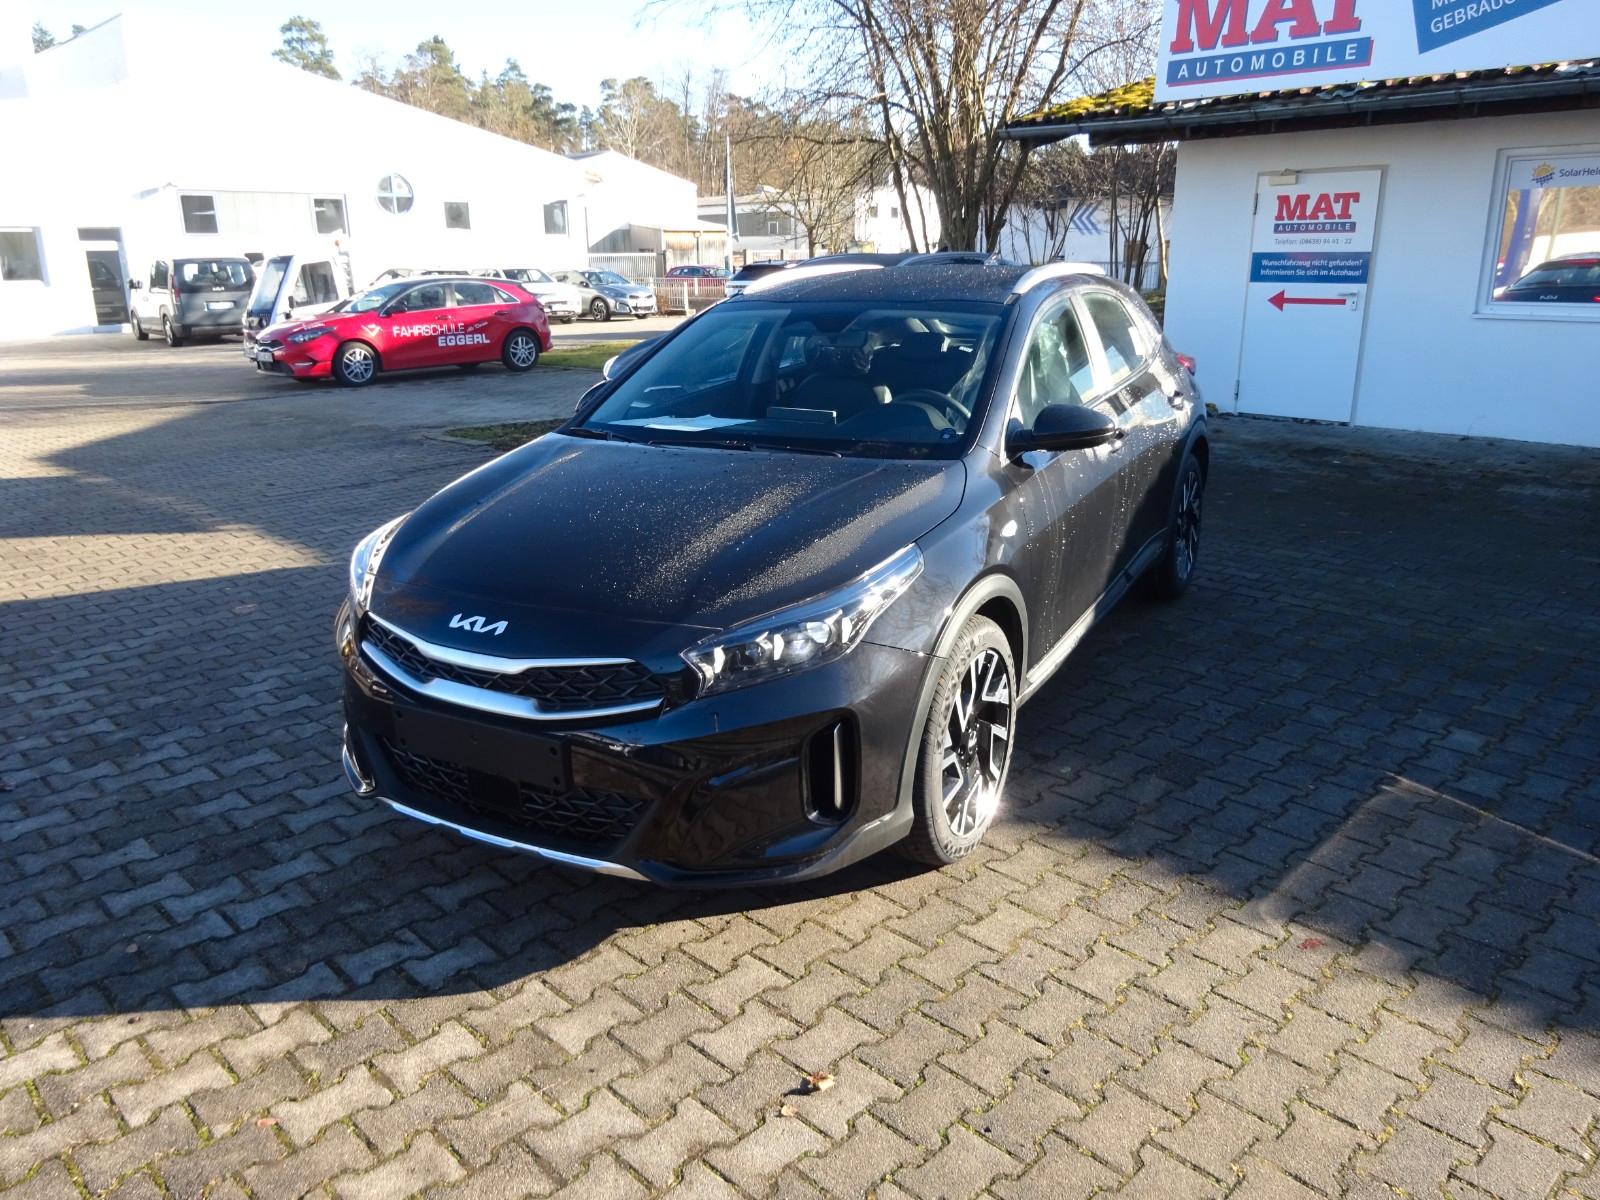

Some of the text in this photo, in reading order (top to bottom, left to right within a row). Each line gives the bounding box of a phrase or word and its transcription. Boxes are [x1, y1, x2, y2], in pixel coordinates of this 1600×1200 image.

[1177, 43, 1358, 79] AUTOMOBILE
[1275, 192, 1360, 221] MAT
[1277, 223, 1351, 231] AUTOMOBILE
[1261, 259, 1310, 267] Wunschfahrzeug
[1328, 259, 1363, 268] gefunden?
[1260, 268, 1362, 276] Informieren Sie sich im Autohaus!
[392, 323, 465, 338] FAHRSCHULE
[438, 333, 491, 347] EGGERL
[449, 613, 509, 636] KIA
